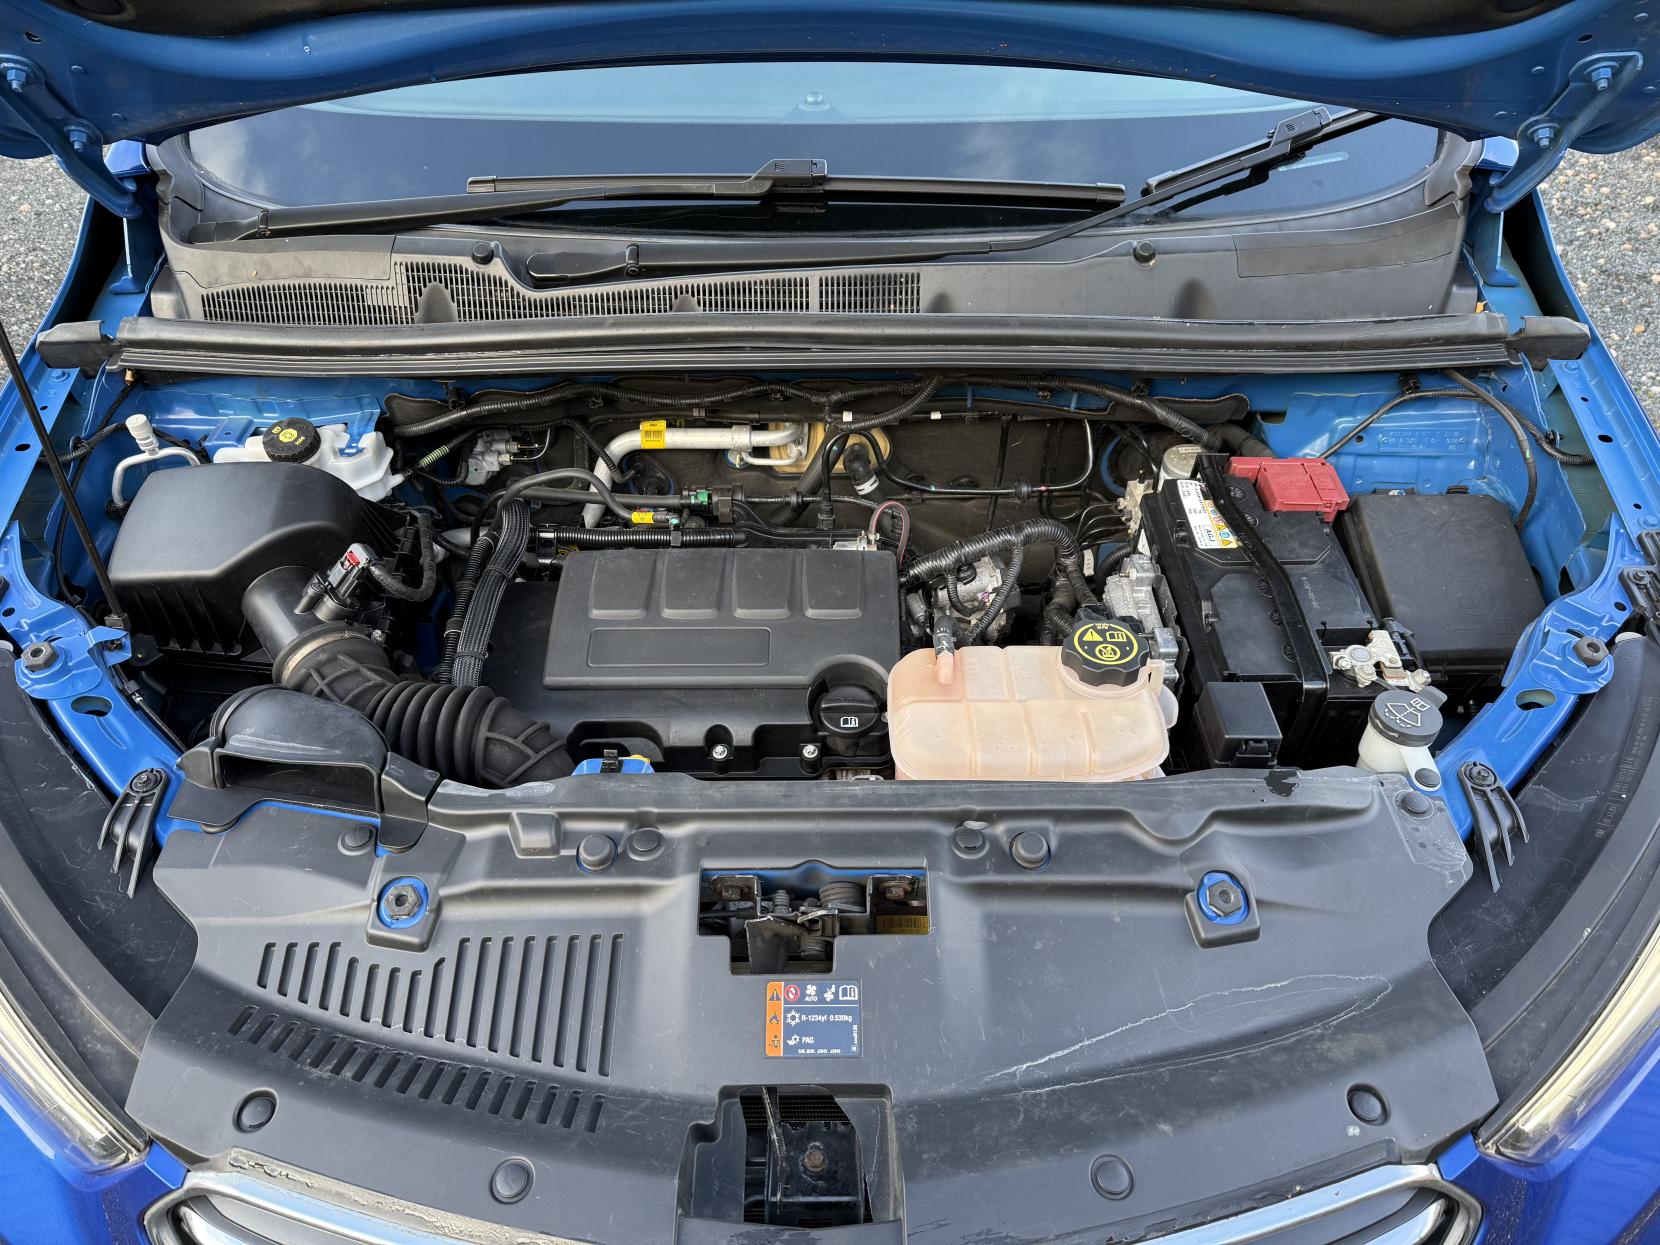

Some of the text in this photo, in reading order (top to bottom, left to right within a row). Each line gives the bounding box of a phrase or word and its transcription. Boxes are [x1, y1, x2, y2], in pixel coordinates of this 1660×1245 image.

[801, 1015, 852, 1023] R-1234yf 0.530kg
[802, 1036, 814, 1044] PAG
